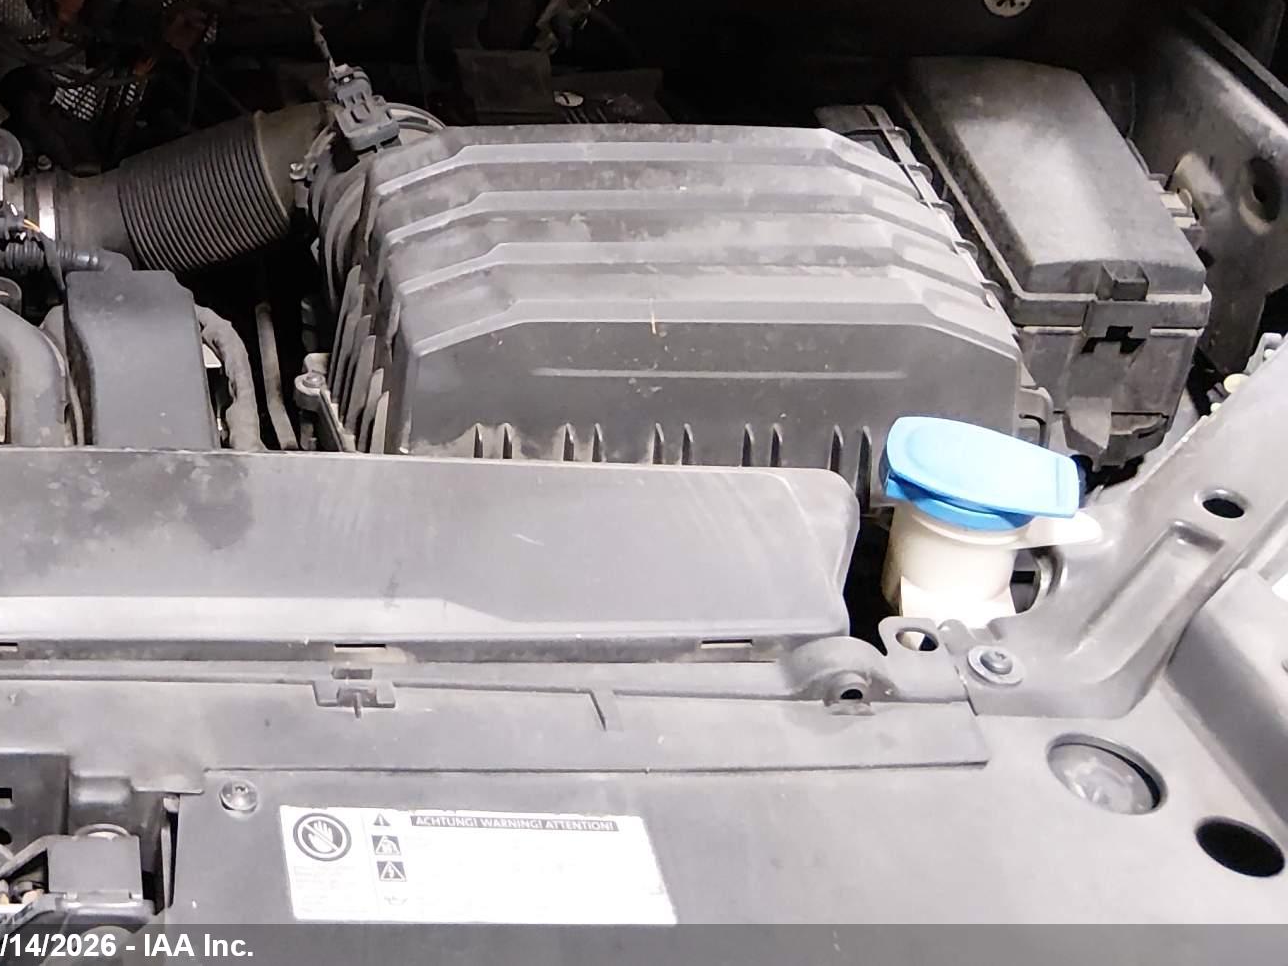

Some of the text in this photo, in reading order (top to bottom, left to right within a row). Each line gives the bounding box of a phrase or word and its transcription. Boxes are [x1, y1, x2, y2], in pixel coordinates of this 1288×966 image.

[415, 816, 614, 832] ACHTUNG! WARNING! ATTENTION!
